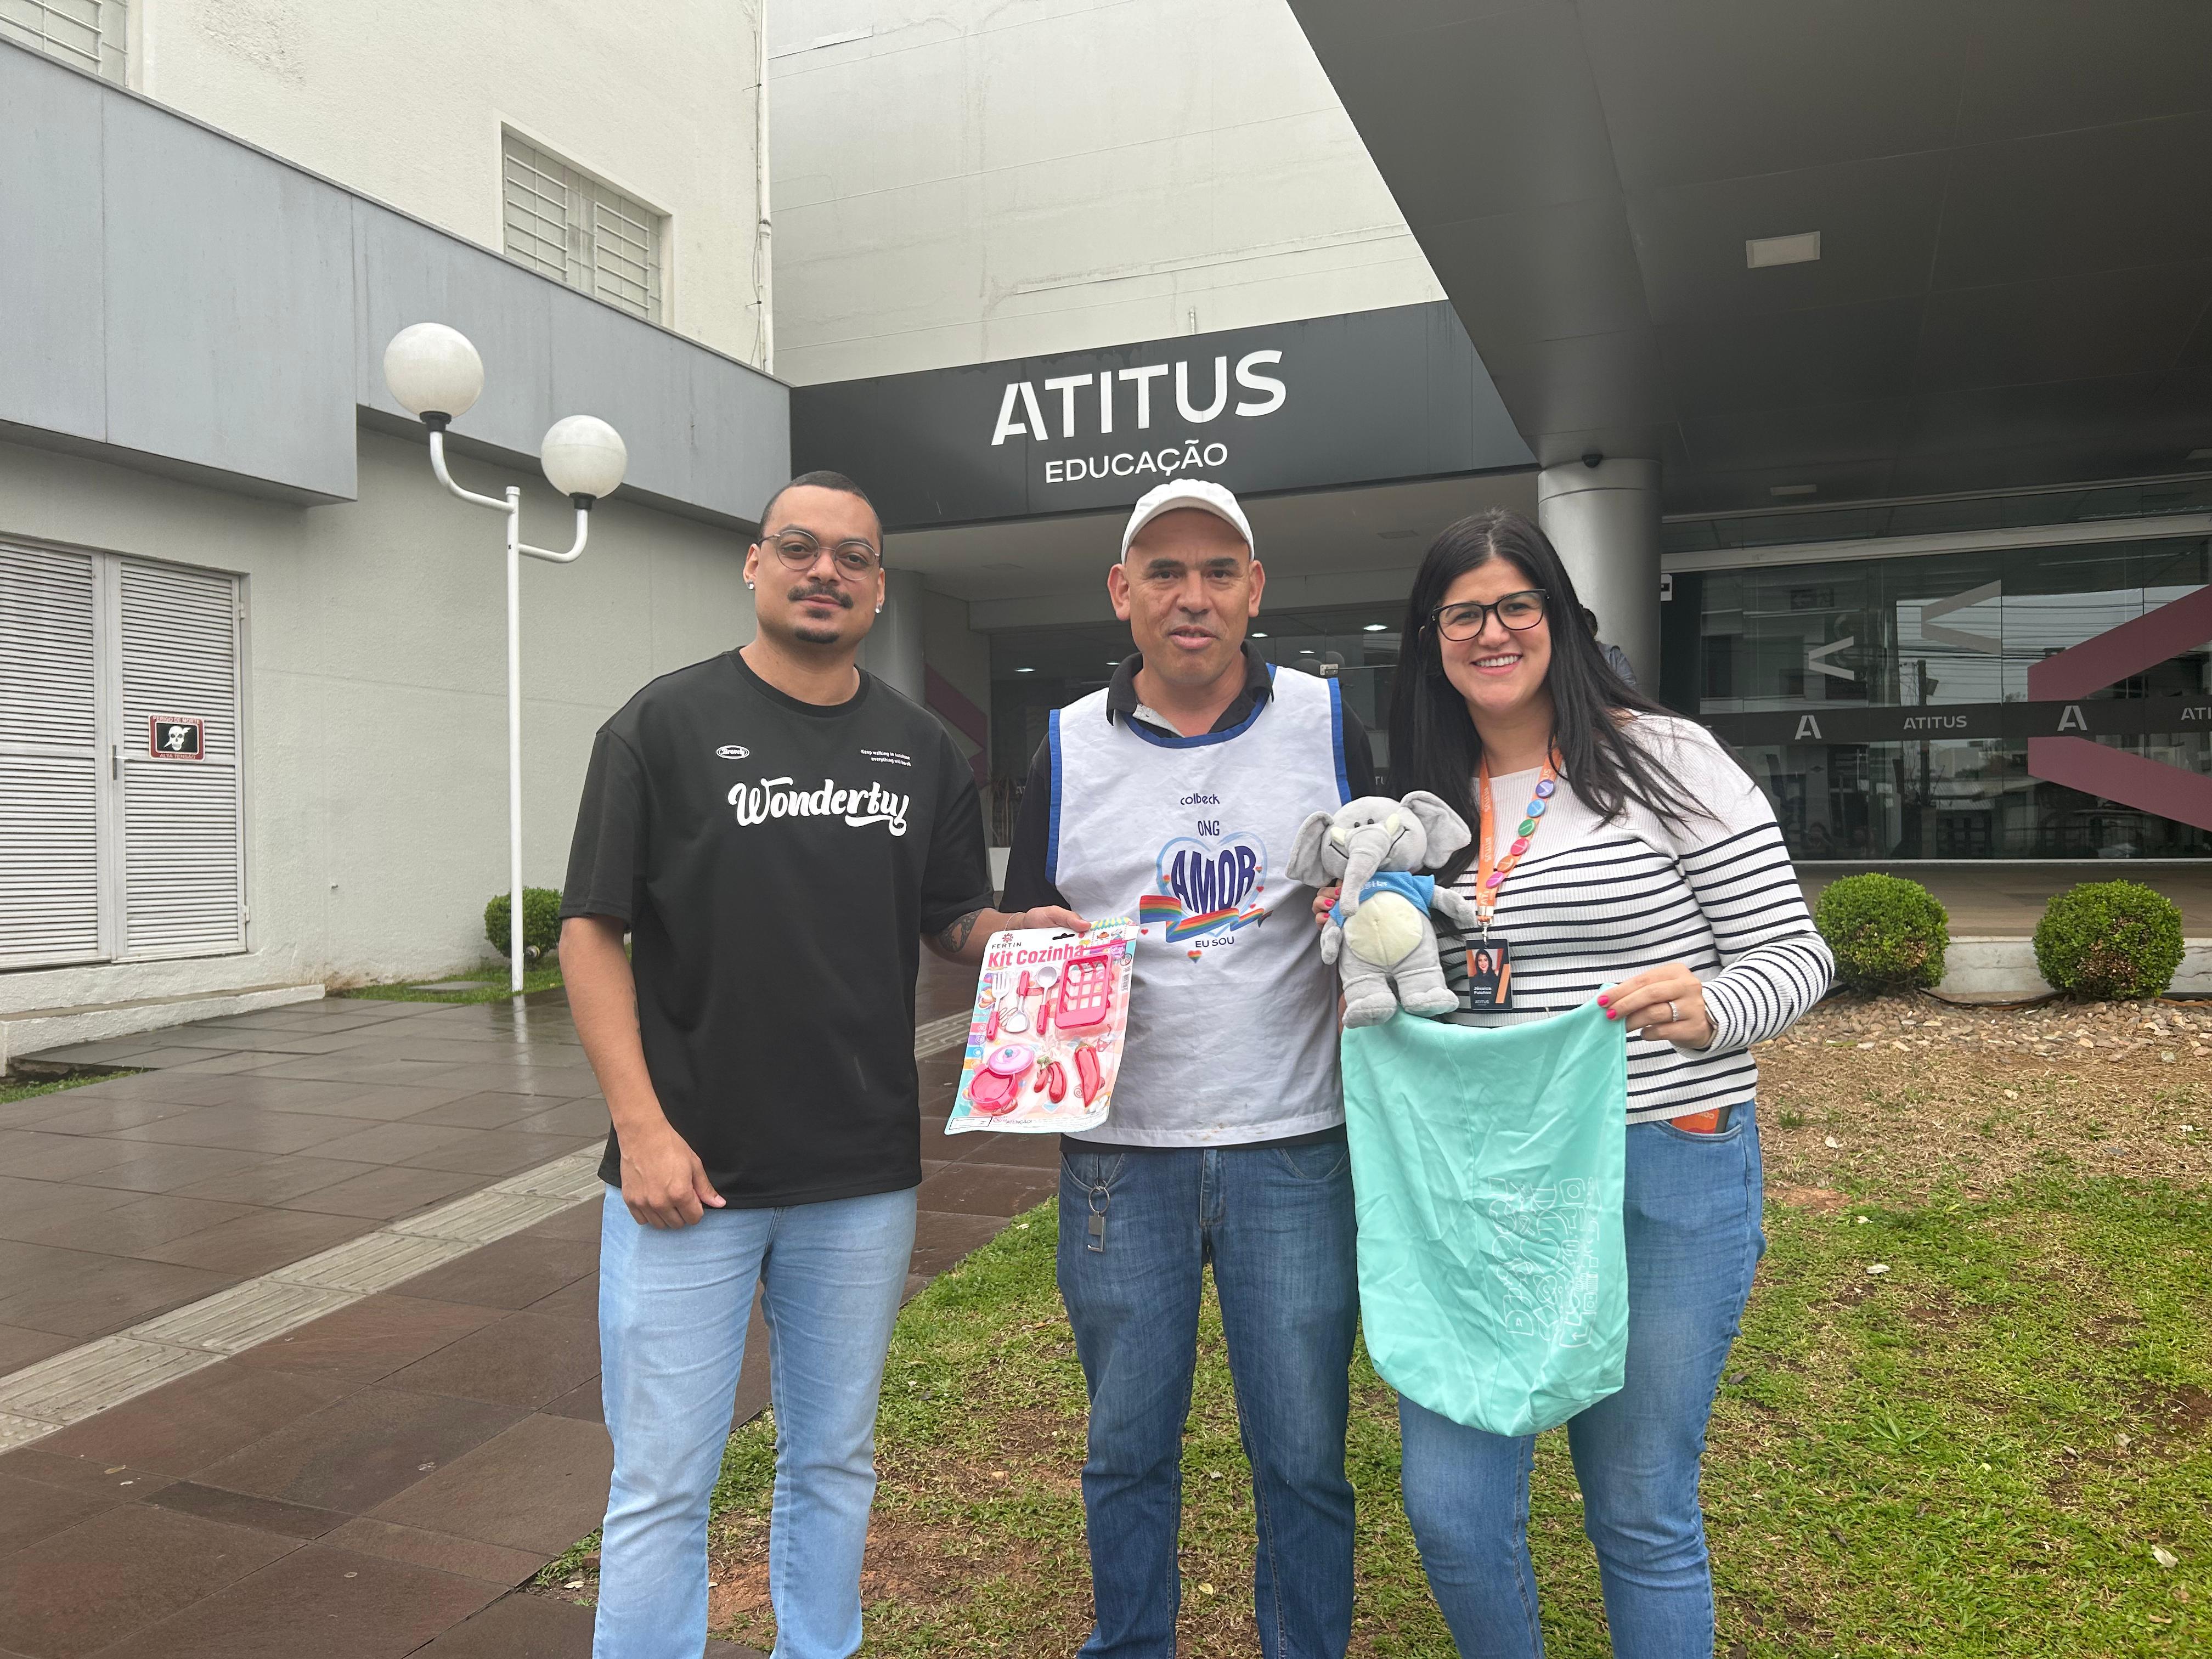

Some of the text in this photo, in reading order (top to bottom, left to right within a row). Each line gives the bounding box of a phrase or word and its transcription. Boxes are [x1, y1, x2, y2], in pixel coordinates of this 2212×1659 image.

[991, 349, 1286, 445] ATITUS
[1045, 439, 1227, 483] EDUCAÇÃO
[1903, 715, 1967, 730] ATITUS
[1180, 793, 1220, 805] colbeck
[1197, 820, 1220, 836] ONG
[1171, 845, 1256, 914] AMOR
[991, 941, 1022, 950] FERTIN
[1195, 936, 1235, 948] EU SOU
[988, 943, 1086, 967] Kit Cozinha
